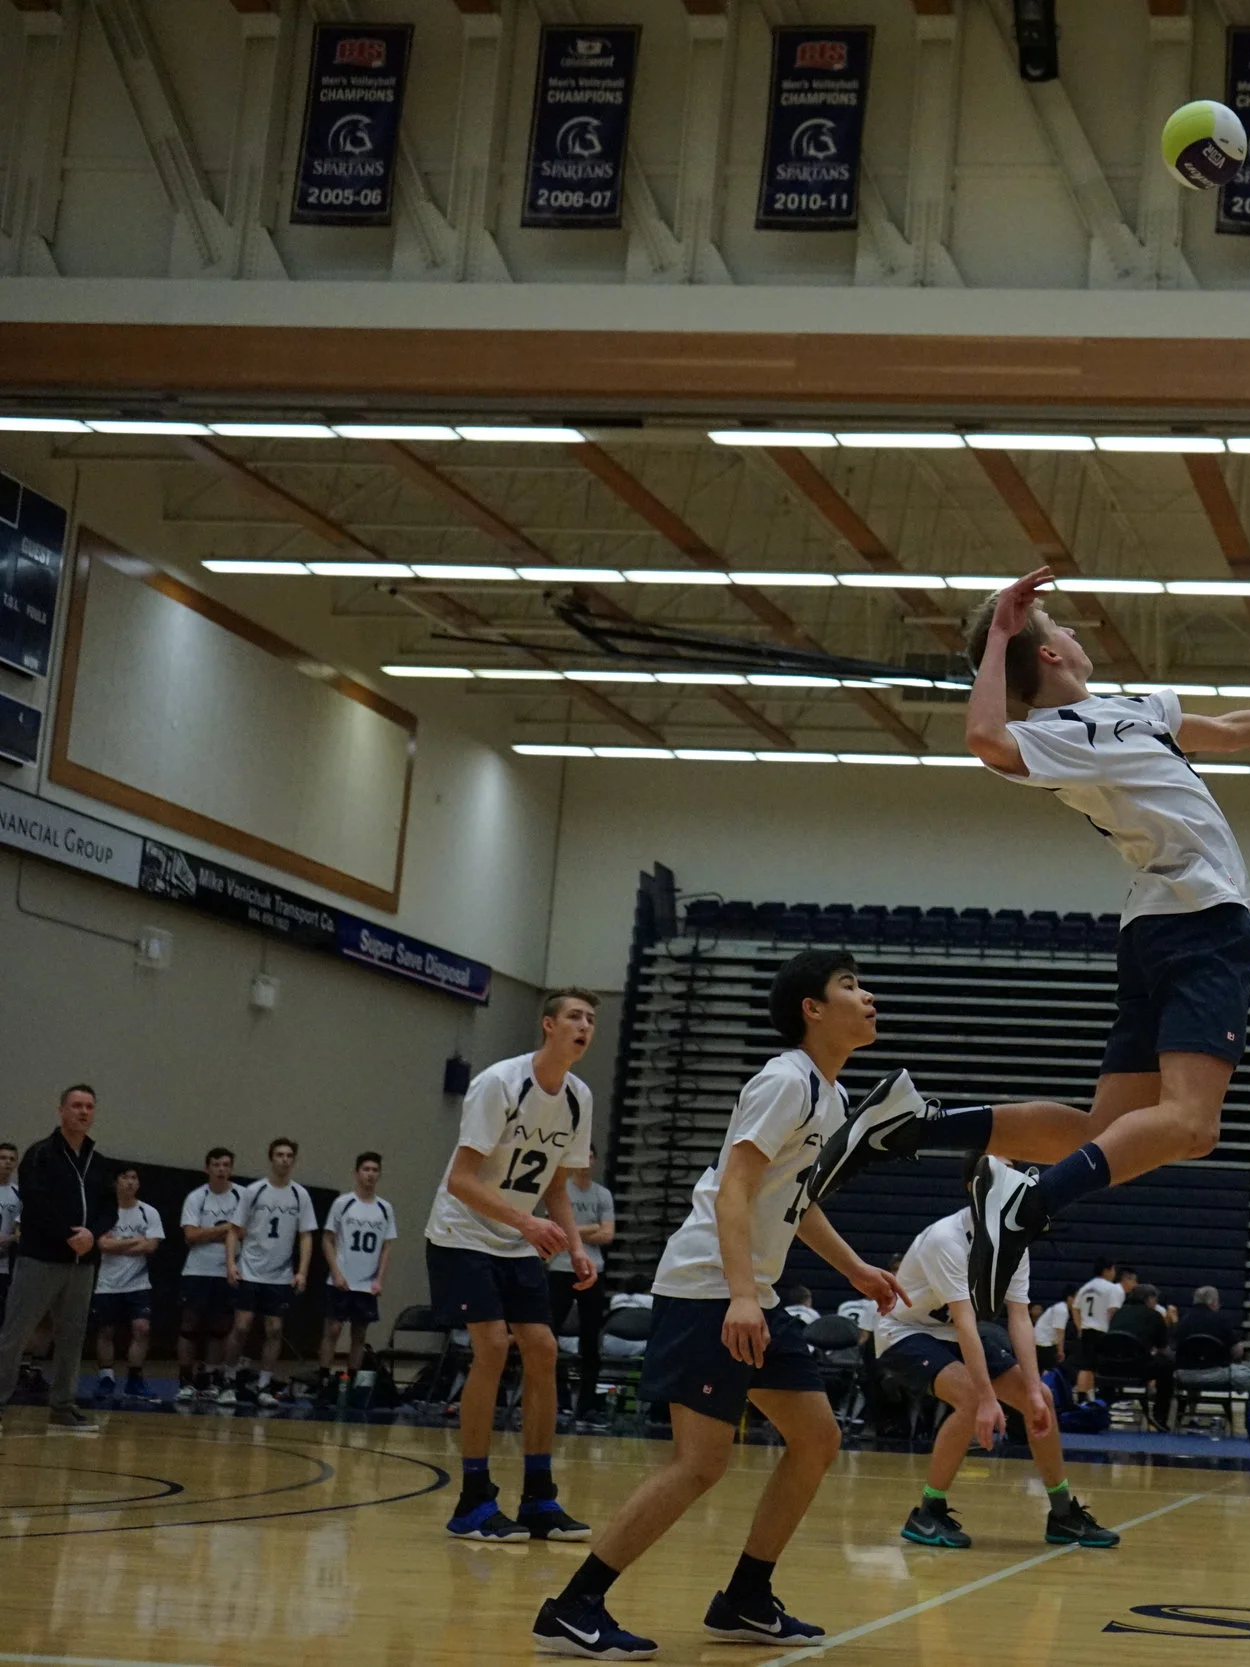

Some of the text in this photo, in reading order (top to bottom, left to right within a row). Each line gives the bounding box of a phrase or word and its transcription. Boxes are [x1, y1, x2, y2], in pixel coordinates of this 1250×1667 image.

[320, 88, 394, 102] CHAMPIONS
[547, 90, 624, 104] CHAMPIONS
[780, 92, 857, 106] CHAMPIONS
[313, 159, 384, 177] SPARTANS
[541, 161, 613, 180] SPARTANS
[776, 163, 850, 182] SPARTANS
[307, 187, 382, 206] 2005-06
[774, 193, 848, 210] 2010-11
[360, 928, 395, 962] Super
[499, 1148, 548, 1194] 12
[784, 1165, 813, 1225] 1
[268, 1217, 280, 1239] 1
[351, 1230, 378, 1253] 10
